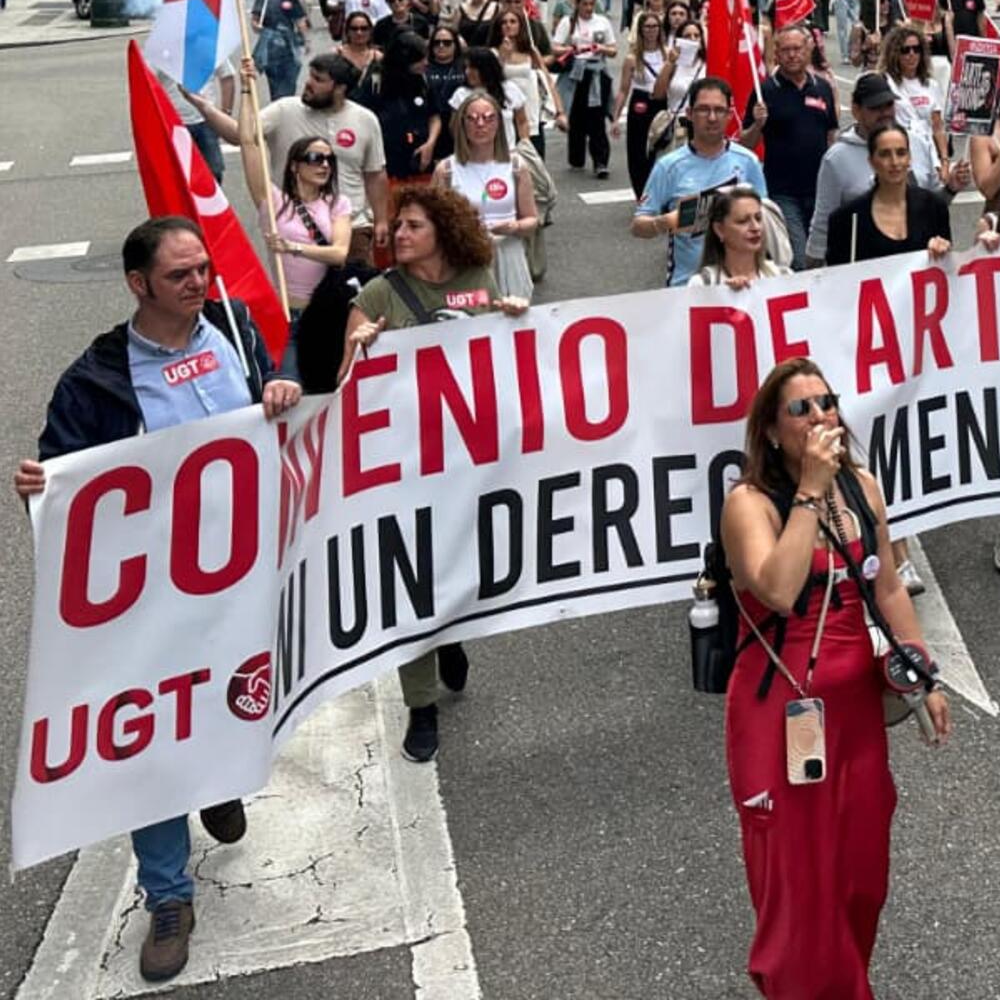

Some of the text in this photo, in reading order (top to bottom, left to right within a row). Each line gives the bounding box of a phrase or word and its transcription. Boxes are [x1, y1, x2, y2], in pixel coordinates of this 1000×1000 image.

[164, 359, 199, 383] UGT
[60, 316, 629, 628] CONVENIO
[273, 558, 306, 714] NI
[327, 506, 435, 650] UN
[477, 449, 748, 601] DEREC
[30, 669, 210, 783] UGT
